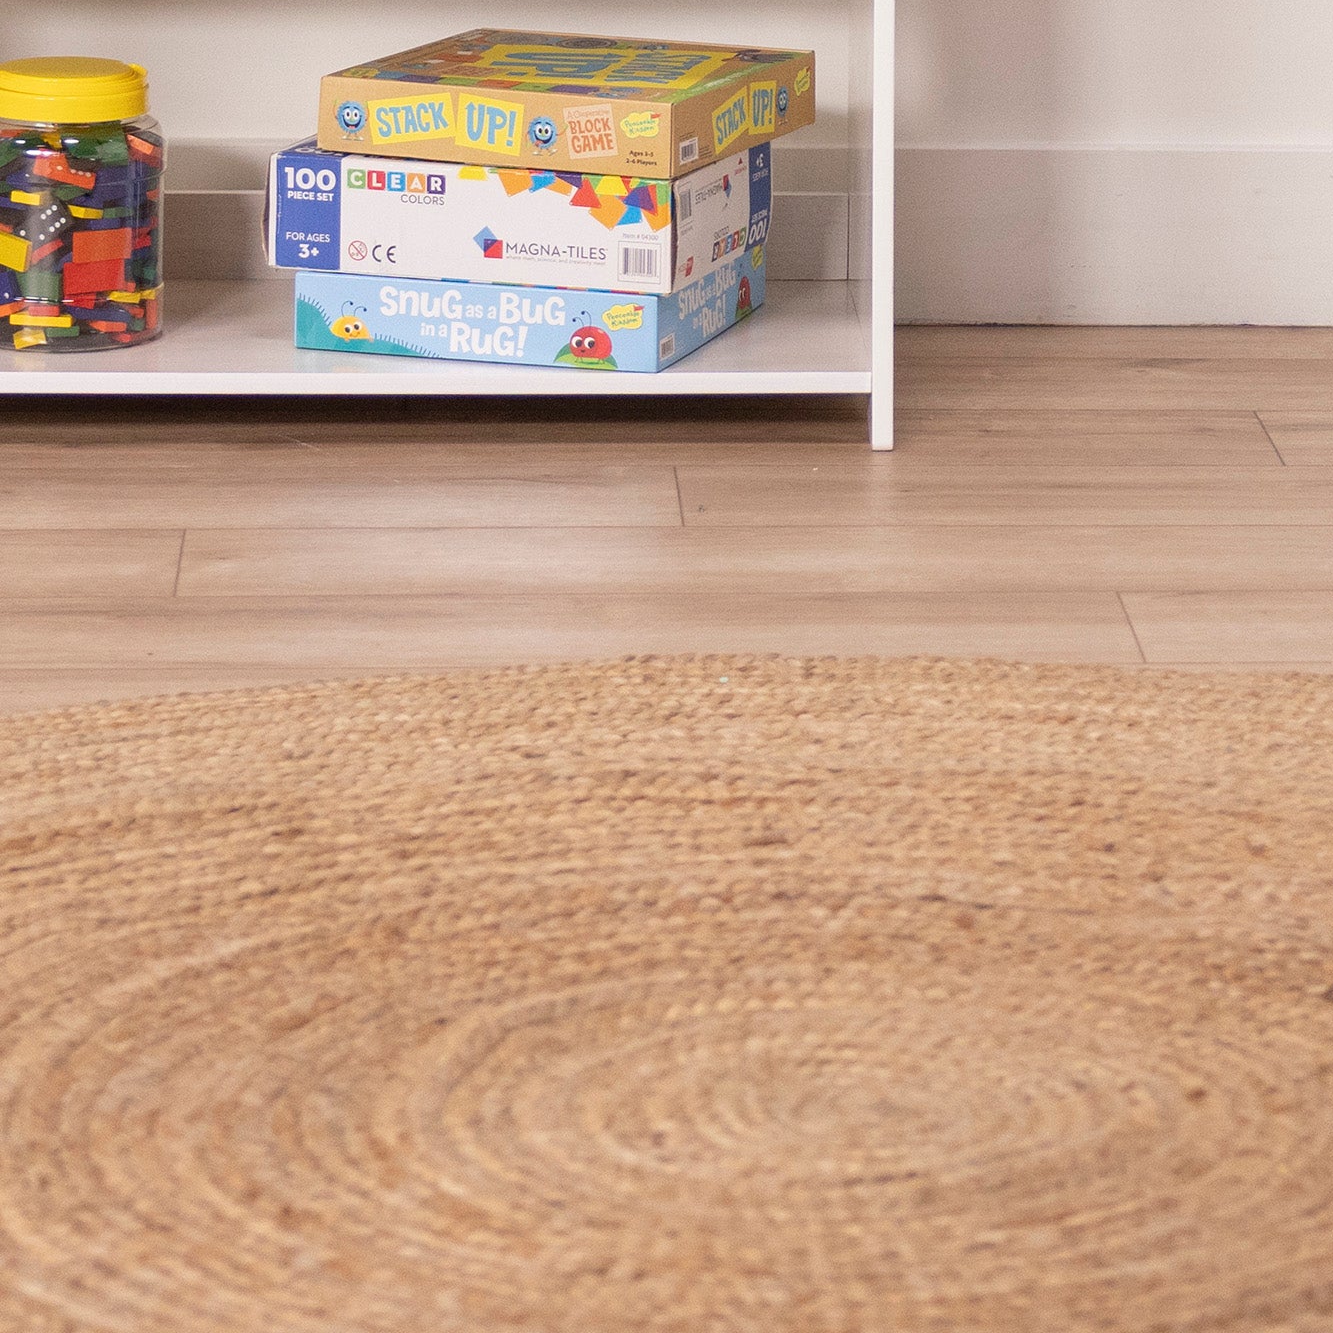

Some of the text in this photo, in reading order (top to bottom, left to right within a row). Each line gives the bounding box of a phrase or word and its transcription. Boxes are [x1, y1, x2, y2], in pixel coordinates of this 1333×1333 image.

[376, 101, 517, 147] STACK UP!
[716, 88, 773, 145] STACK UP!
[567, 117, 612, 134] BLOCK
[571, 132, 614, 154] GAME
[284, 167, 337, 191] 100
[349, 170, 445, 194] CLEAR
[287, 191, 334, 202] PIECE SET
[400, 194, 445, 206] COLORS
[286, 232, 330, 243] FOR AGES
[298, 244, 320, 259] 3+
[506, 242, 607, 261] MAGNA-TILES
[465, 304, 483, 318] as
[487, 305, 497, 319] a
[420, 322, 435, 337] in
[438, 324, 447, 337] a
